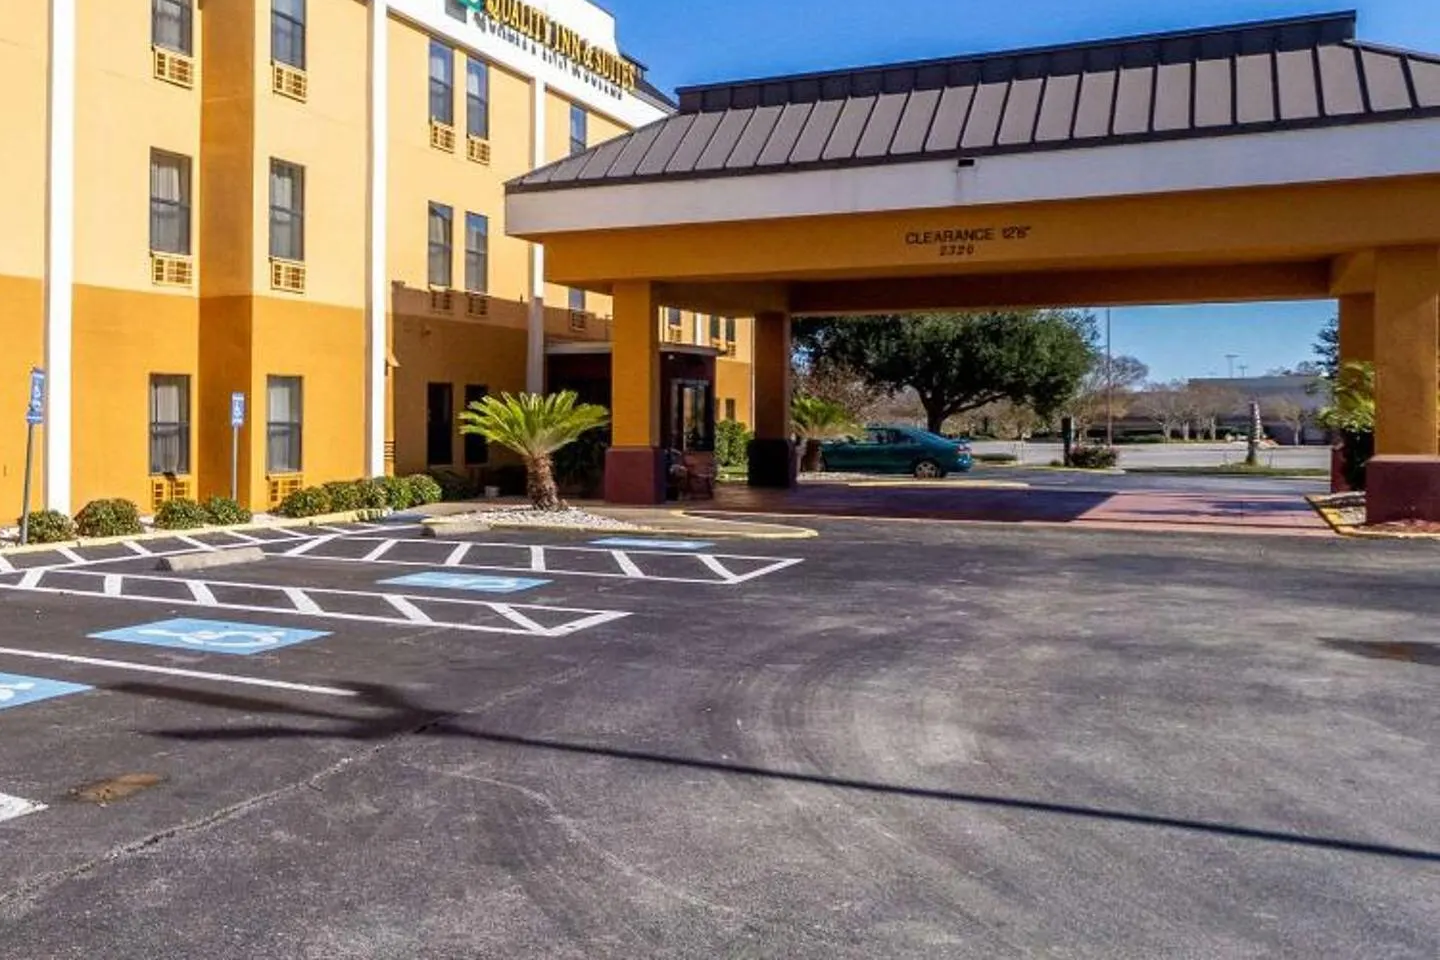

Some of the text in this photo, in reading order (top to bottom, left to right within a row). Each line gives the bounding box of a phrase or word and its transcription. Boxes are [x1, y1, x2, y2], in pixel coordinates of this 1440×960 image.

[554, 22, 580, 63] INN
[595, 46, 636, 90] SUITES
[904, 227, 994, 245] CLEARANCE
